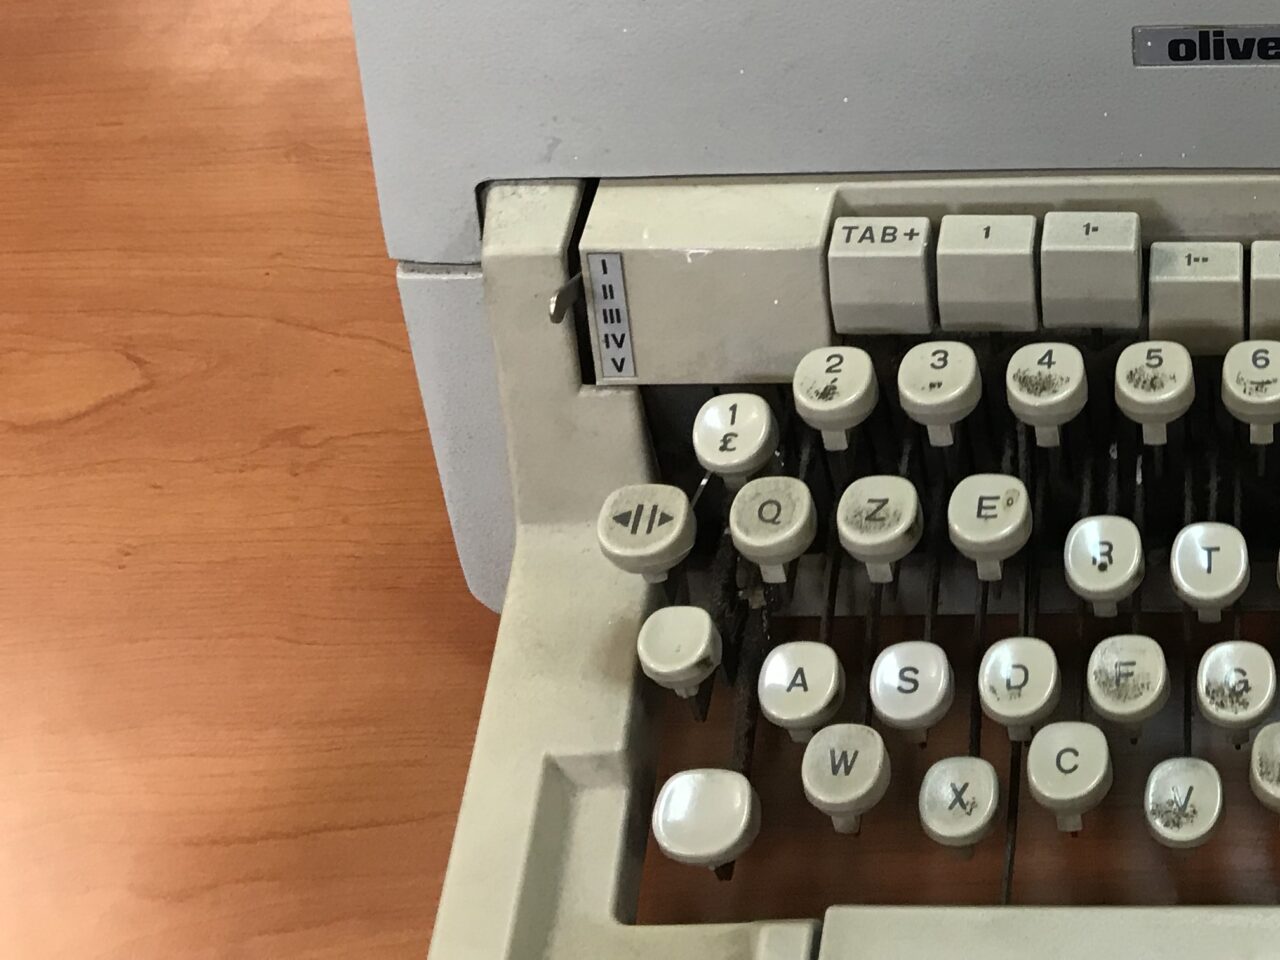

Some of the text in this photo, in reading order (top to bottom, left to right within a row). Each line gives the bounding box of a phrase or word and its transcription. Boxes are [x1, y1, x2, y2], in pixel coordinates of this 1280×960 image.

[841, 225, 921, 244] TAB+
[982, 226, 992, 239] 1
[602, 284, 615, 300] II
[602, 308, 622, 324] III
[603, 333, 626, 349] IV
[611, 357, 626, 373] V
[825, 353, 844, 374] 2
[930, 349, 950, 370] 3
[1037, 349, 1057, 369] 4
[1145, 348, 1164, 369] 5
[1251, 348, 1271, 369] 6
[728, 403, 739, 426] 1
[719, 432, 739, 452] £
[757, 499, 782, 526] Q
[864, 497, 890, 522] Z
[976, 495, 1001, 520] E
[1201, 546, 1221, 574] T
[785, 666, 810, 693] A
[896, 666, 920, 694] S
[1006, 664, 1030, 691] D
[1114, 660, 1137, 687] F
[1225, 667, 1252, 693] G
[828, 748, 859, 777] W
[1055, 746, 1080, 775] C
[948, 781, 970, 811] X
[1171, 785, 1195, 814] V
